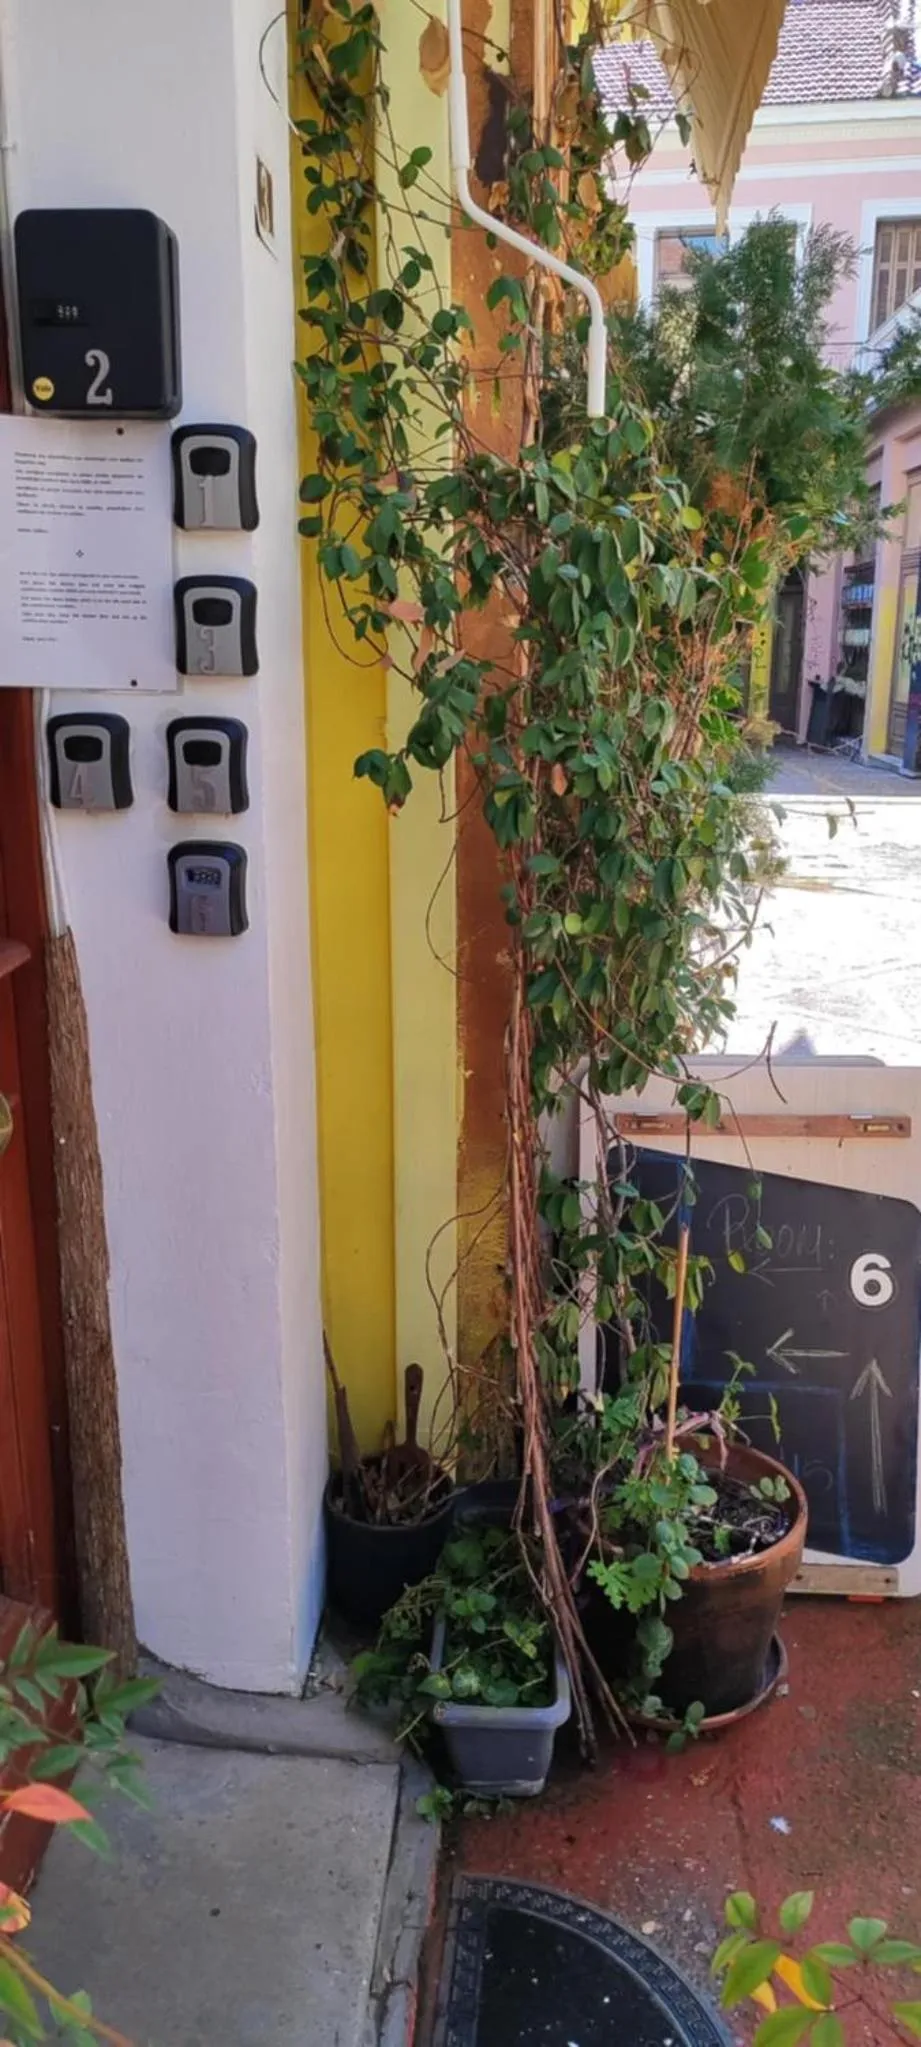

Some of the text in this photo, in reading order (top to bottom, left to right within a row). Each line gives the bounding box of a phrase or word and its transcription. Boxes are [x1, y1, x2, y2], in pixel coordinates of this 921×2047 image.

[85, 349, 113, 405] 2
[199, 476, 217, 527] 1
[199, 626, 218, 674] 3
[69, 763, 95, 808] 4
[190, 766, 219, 811] 5
[850, 1253, 894, 1307] 6
